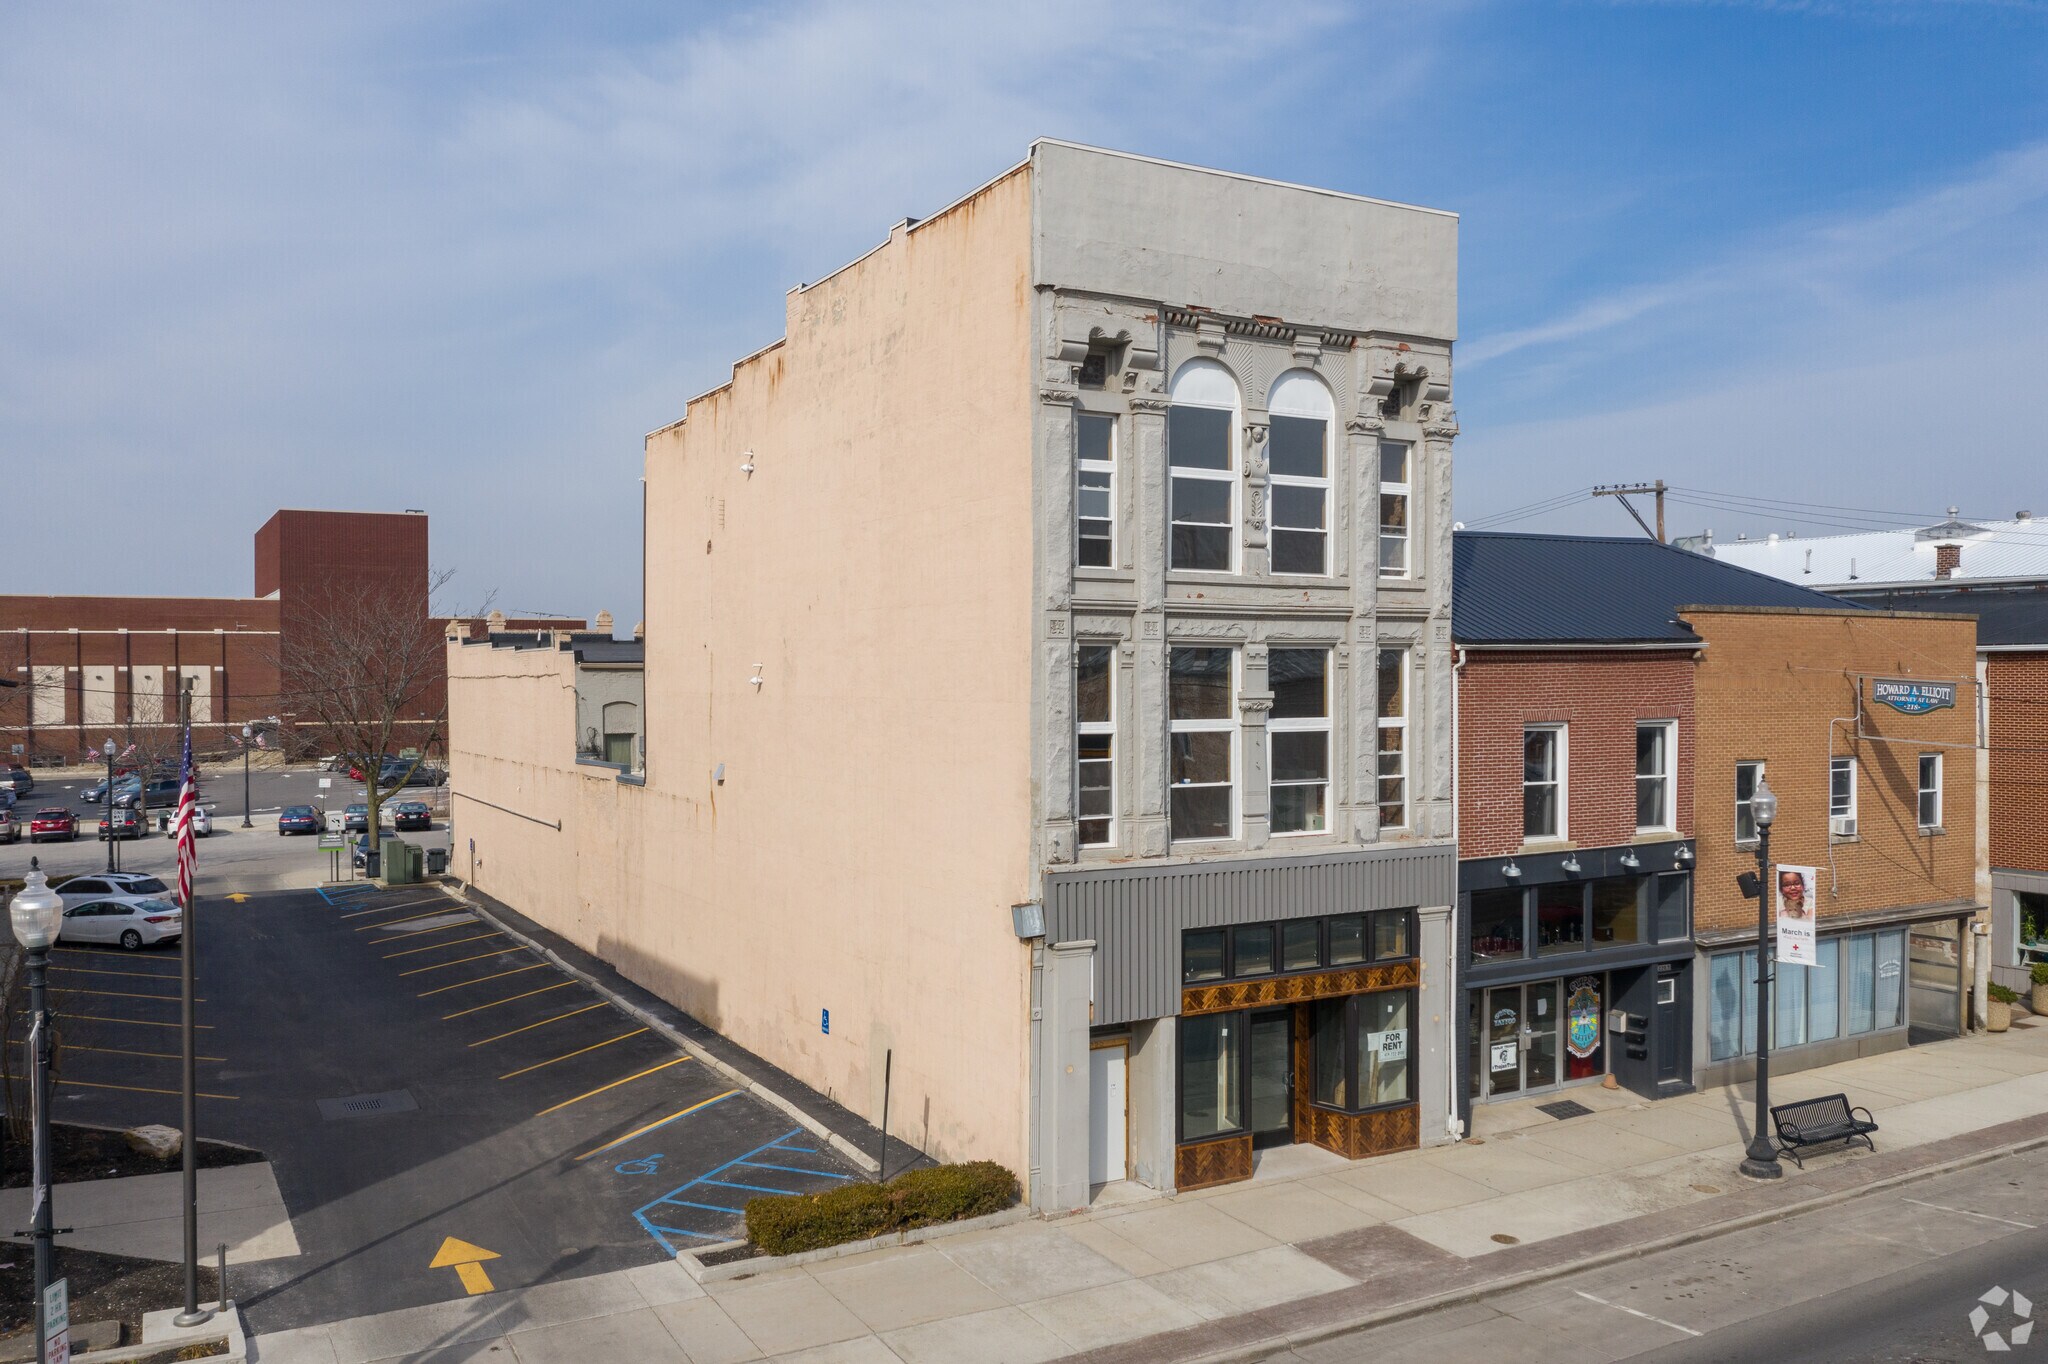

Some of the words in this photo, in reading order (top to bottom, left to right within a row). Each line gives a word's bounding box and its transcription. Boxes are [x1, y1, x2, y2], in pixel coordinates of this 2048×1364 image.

[1877, 684, 1910, 696] HOWARD
[1912, 686, 1919, 695] A.
[1922, 686, 1950, 700] ELLIOTT
[1781, 927, 1803, 936] March
[1493, 1017, 1516, 1027] TATTOO
[1386, 1033, 1400, 1042] FOR
[1383, 1041, 1402, 1051] RENT
[55, 1302, 62, 1313] HR
[46, 1312, 67, 1330] PARKING
[54, 1337, 61, 1347] NO
[48, 1342, 67, 1358] PARKING
